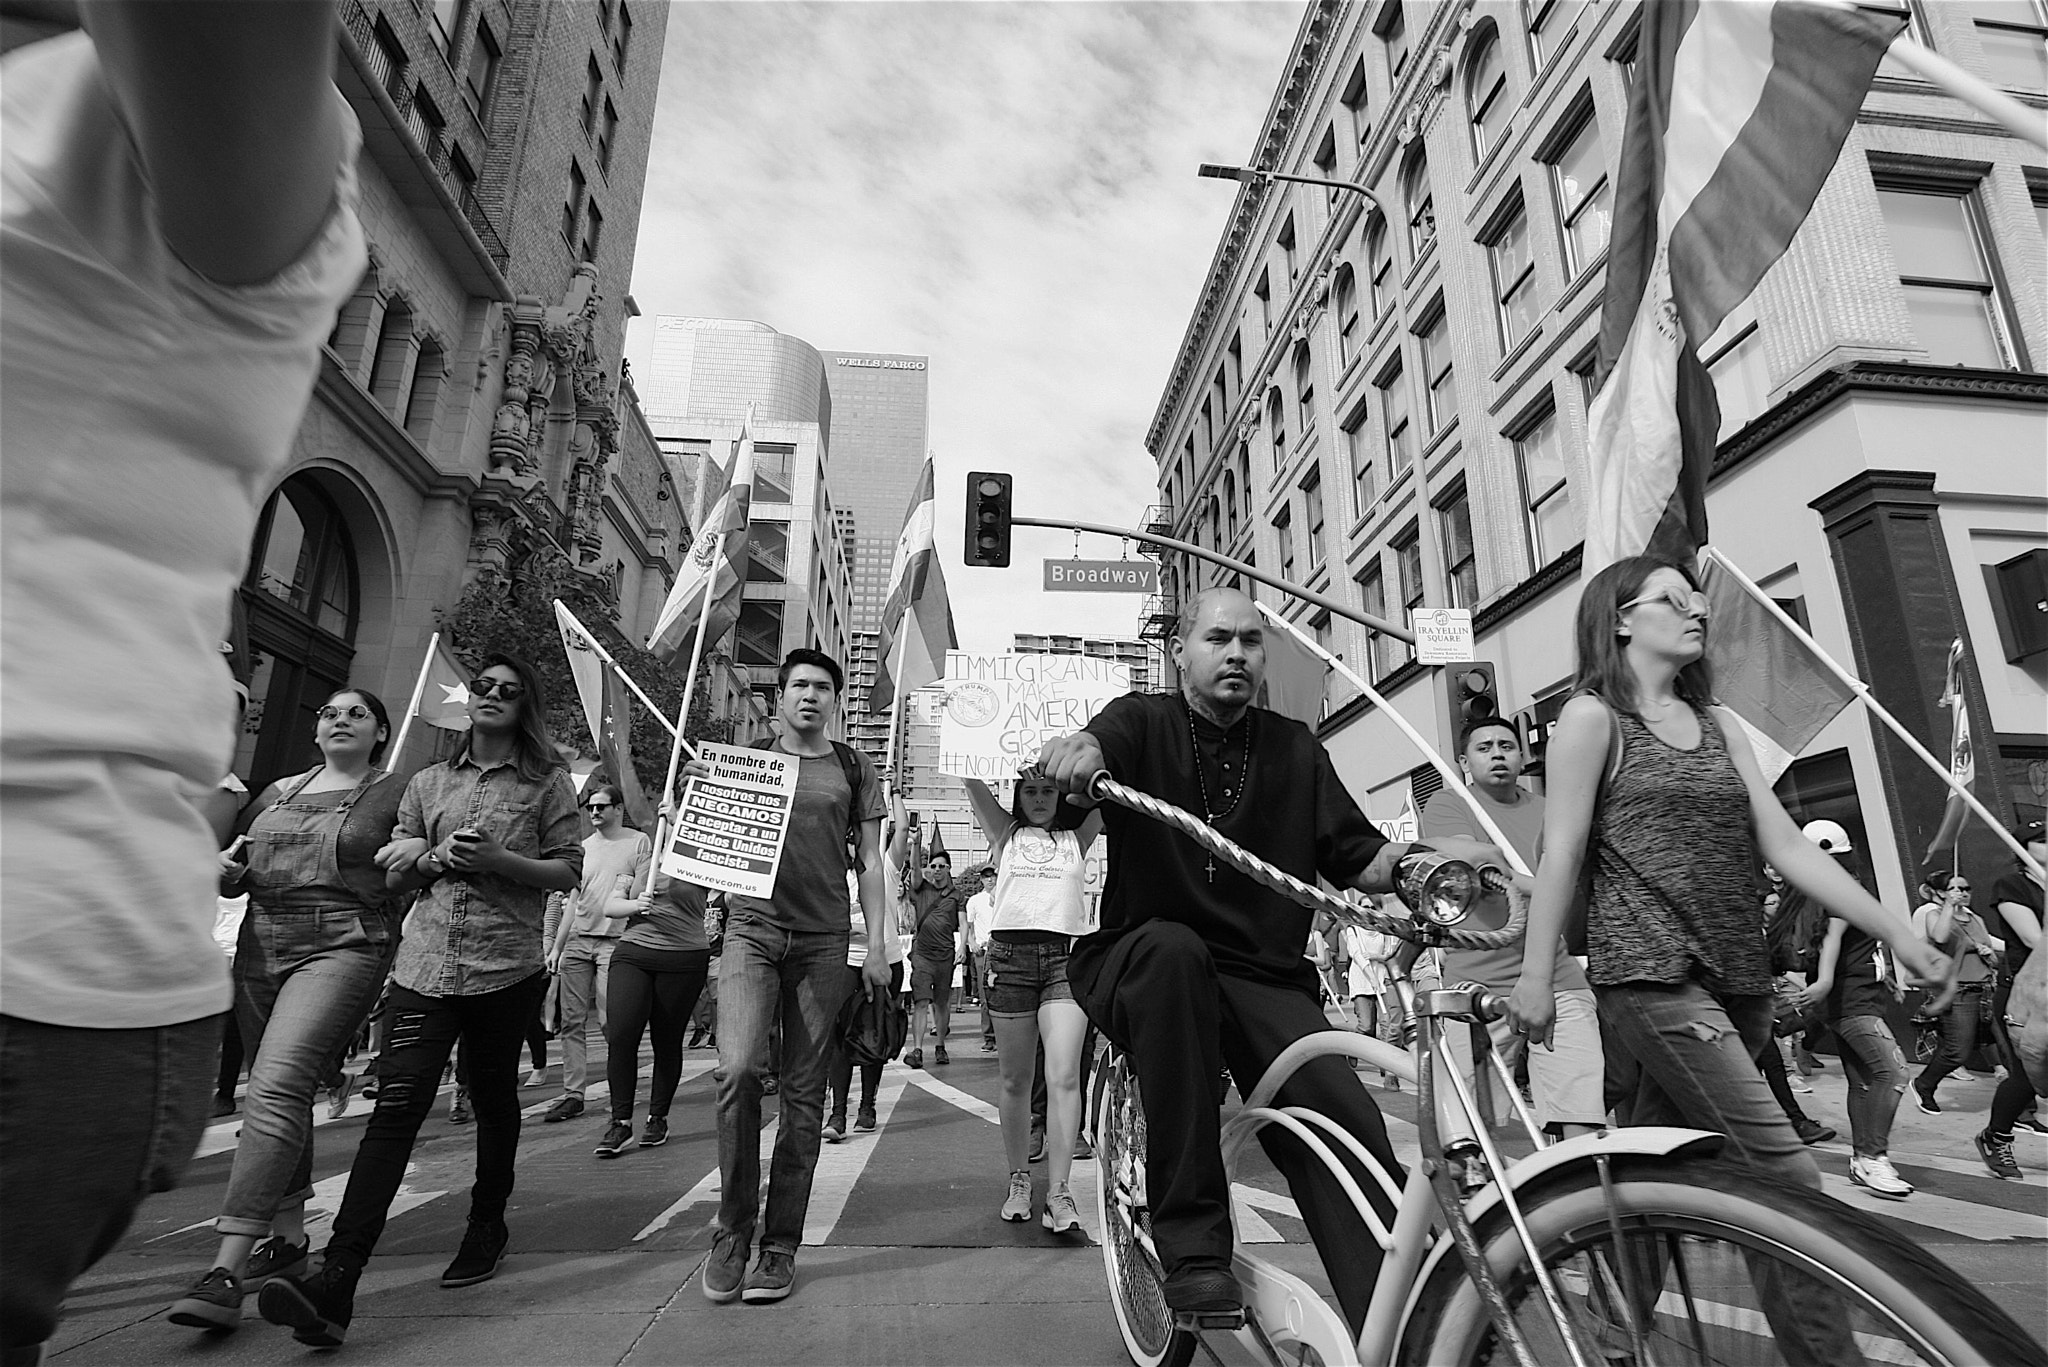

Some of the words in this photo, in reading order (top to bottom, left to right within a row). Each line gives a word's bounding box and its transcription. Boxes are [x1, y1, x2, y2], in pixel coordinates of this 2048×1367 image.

[658, 319, 722, 330] AECOM
[836, 357, 881, 368] WELLS
[883, 360, 926, 371] FARGO
[1052, 565, 1150, 588] Broadway
[1418, 626, 1434, 635] IRA
[1436, 626, 1469, 635] YELLIN
[1427, 634, 1461, 642] SQUARE
[945, 654, 1130, 689] IMMIGRANTS
[1007, 680, 1068, 704] MAKE
[1004, 698, 1104, 730] AMERIC
[701, 749, 717, 762] En
[720, 752, 766, 769] nombre
[769, 759, 785, 772] de
[713, 765, 785, 788] humanidad,
[700, 783, 756, 803] nosotros
[758, 794, 781, 807] nos
[691, 795, 782, 825] NEGAMOS
[685, 812, 696, 823] a
[697, 814, 748, 835] aceptar
[750, 826, 760, 837] a
[761, 829, 778, 841] un
[679, 825, 730, 849] Estados
[732, 838, 777, 857] Unidos
[696, 848, 750, 870] fascista
[676, 867, 758, 893] www.revcom.us
